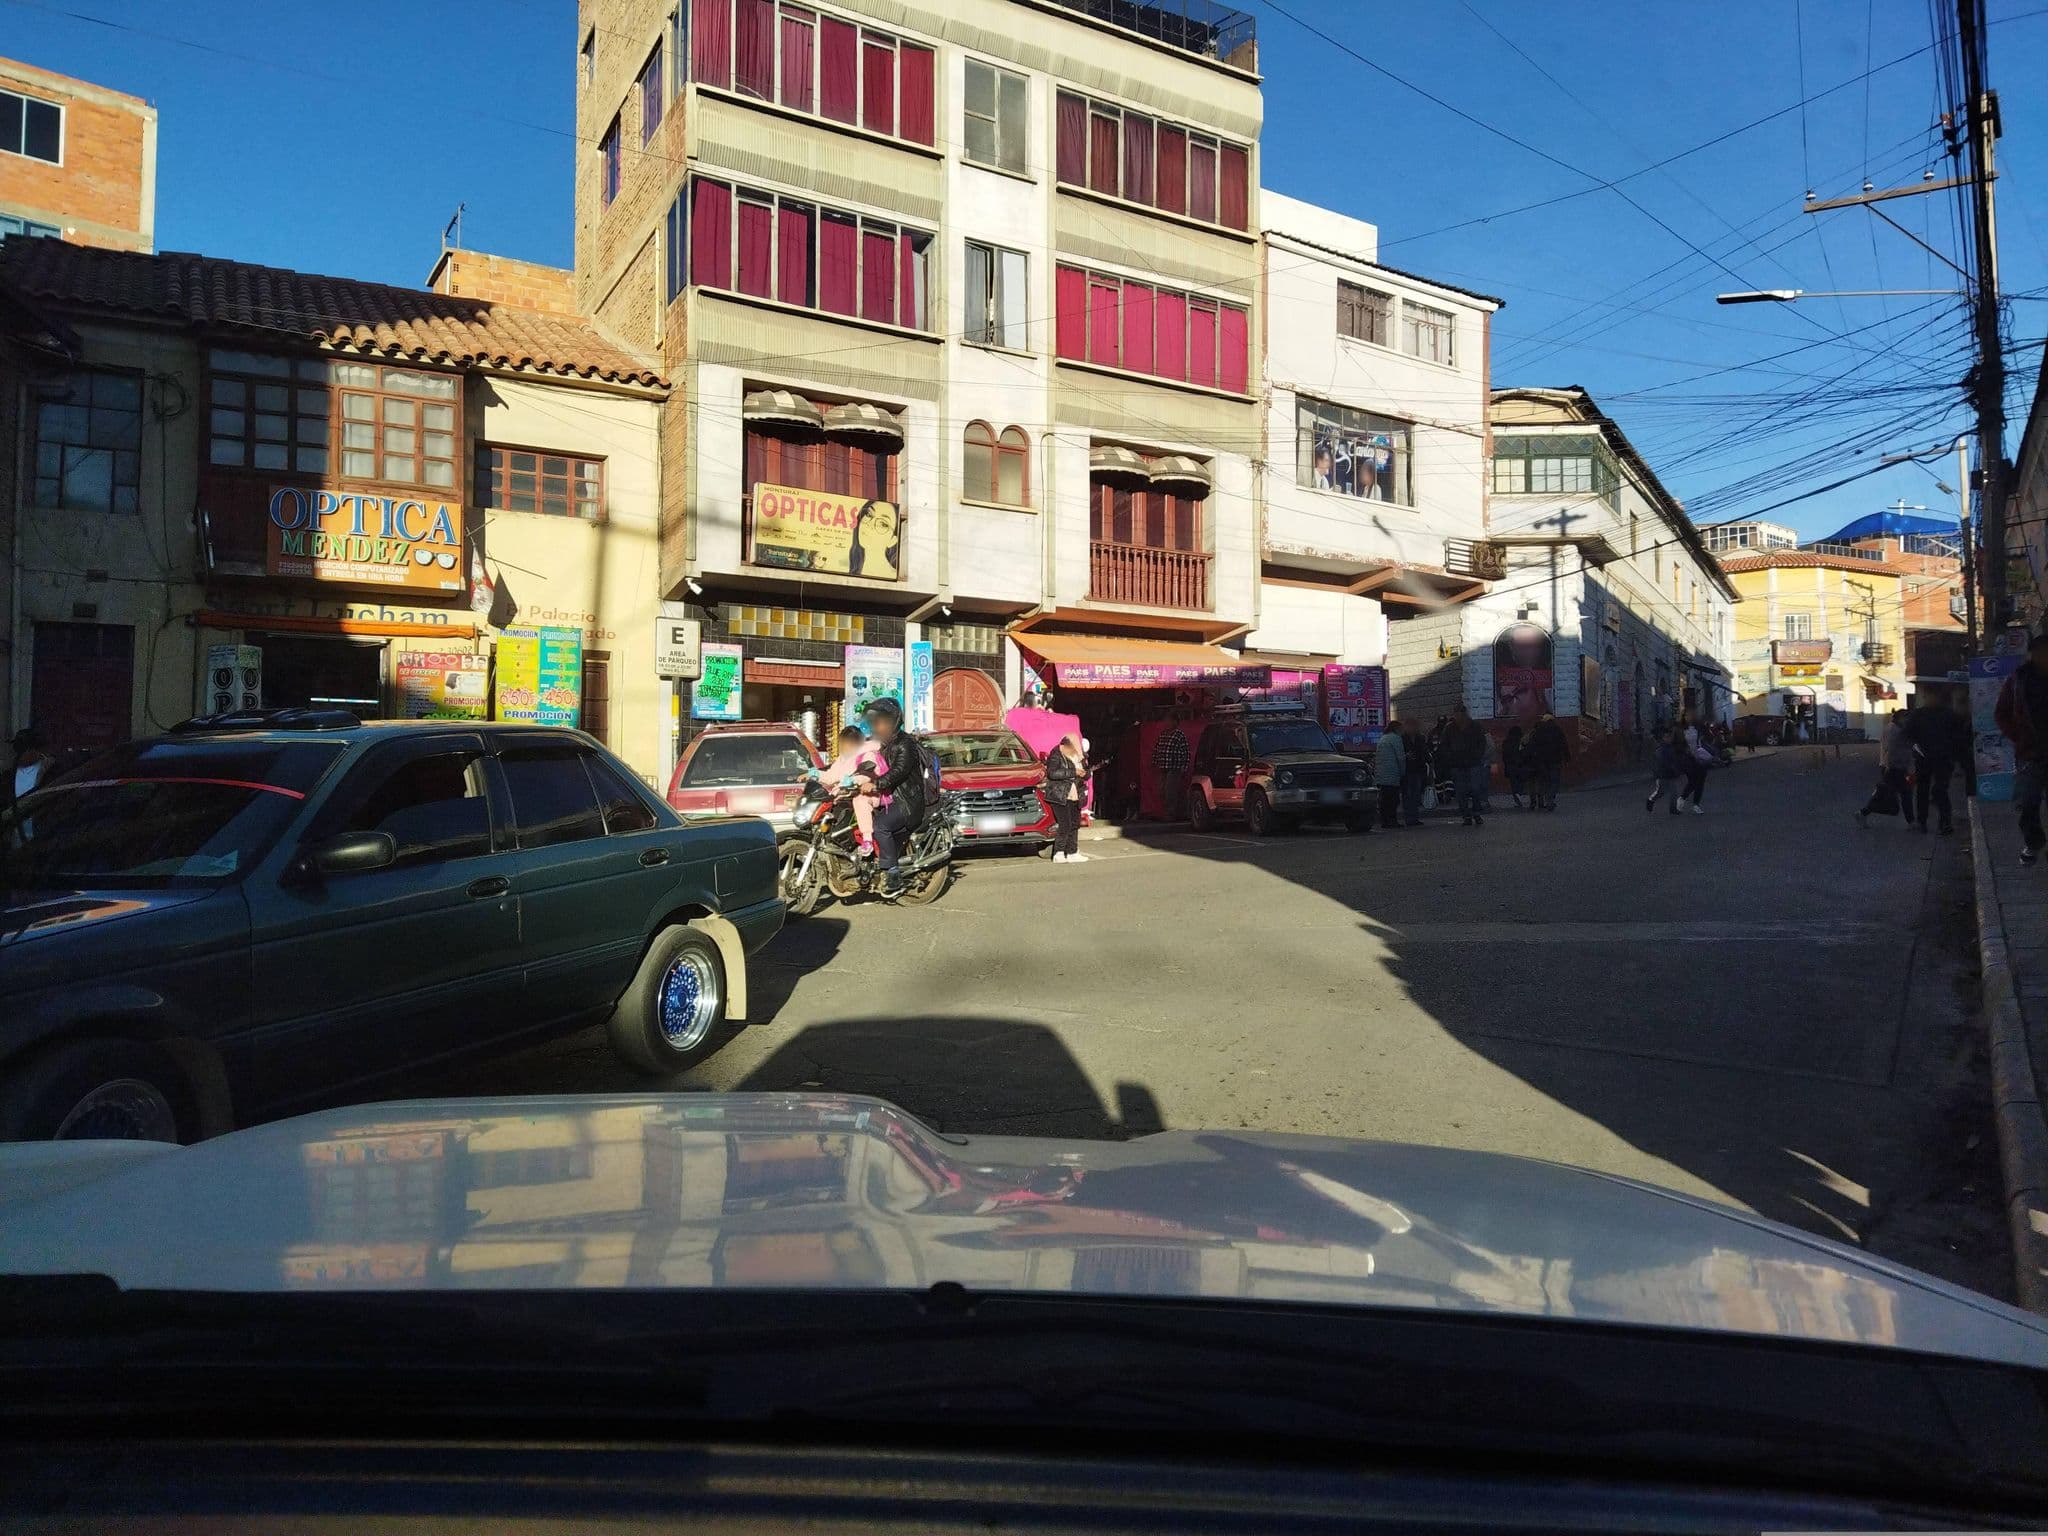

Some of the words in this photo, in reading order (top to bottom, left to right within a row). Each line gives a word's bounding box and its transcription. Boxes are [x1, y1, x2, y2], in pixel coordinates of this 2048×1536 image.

[270, 487, 461, 547] OPTICA
[761, 493, 859, 529] OPTICAS
[280, 530, 411, 566] MENDEZ
[530, 606, 596, 623] Palacio
[672, 627, 684, 645] E
[668, 657, 697, 665] PARQUEO
[1064, 668, 1088, 677] PAES
[1095, 665, 1130, 676] PAES
[1136, 669, 1160, 677] PAES
[1175, 669, 1199, 678] PAES
[1204, 666, 1236, 676] PAES
